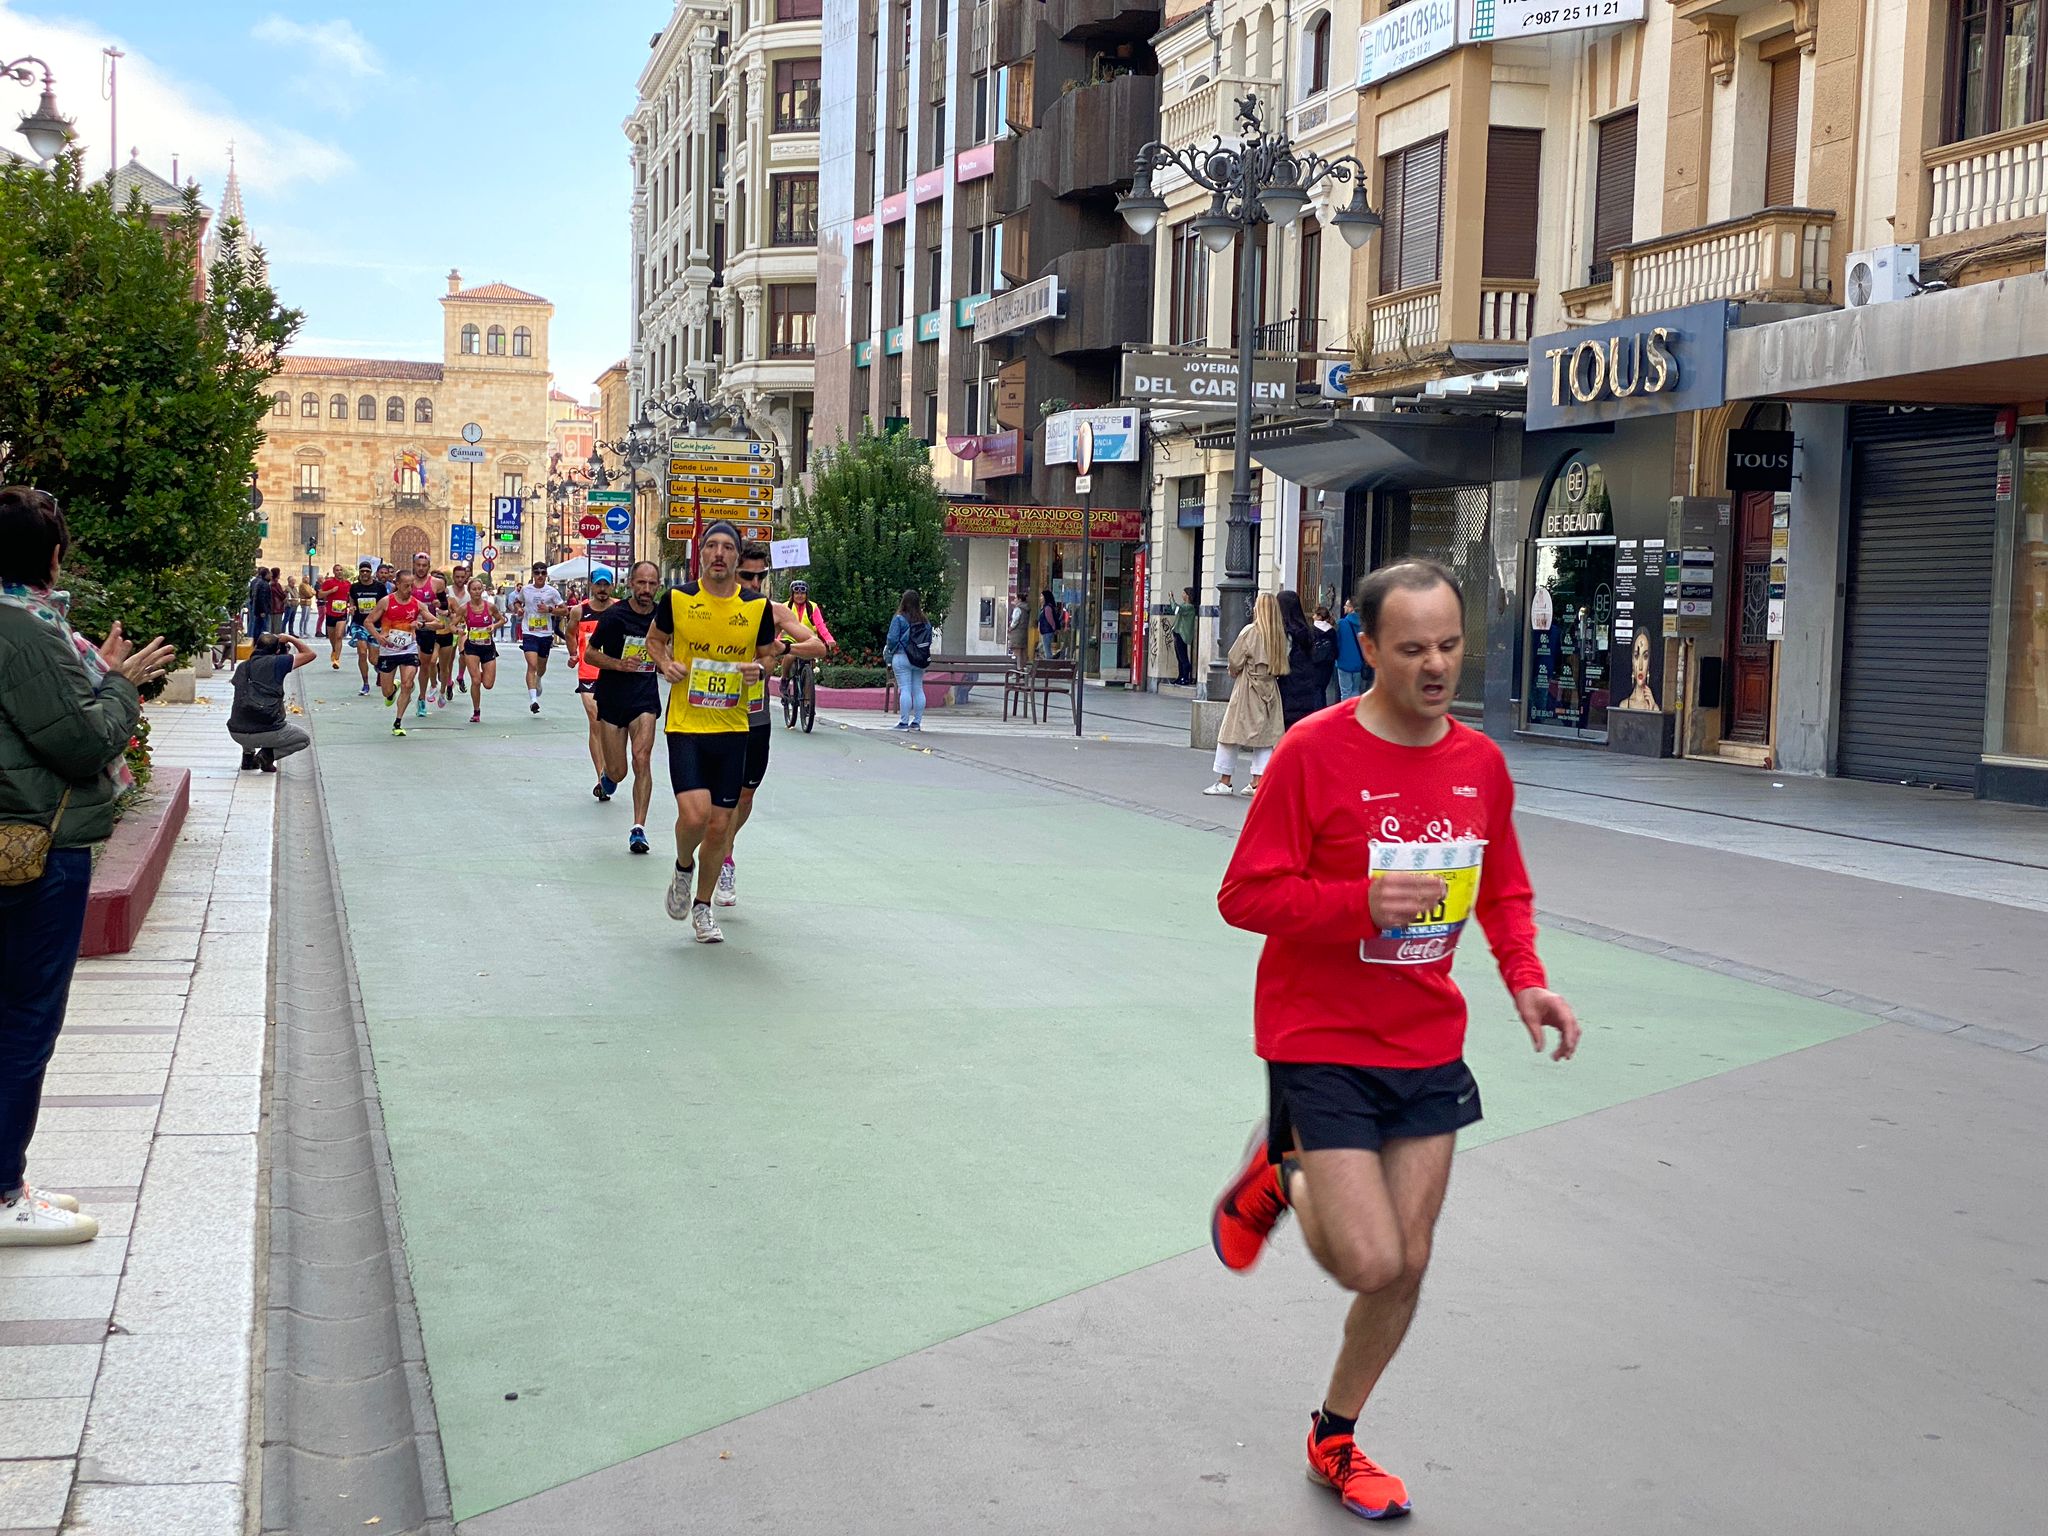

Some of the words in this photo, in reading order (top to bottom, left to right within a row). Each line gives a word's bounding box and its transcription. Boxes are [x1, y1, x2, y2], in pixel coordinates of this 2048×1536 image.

[1535, 10, 1561, 25] 987
[1563, 7, 1580, 21] 25
[1585, 5, 1598, 18] 11
[1604, 2, 1619, 15] 21
[1184, 363, 1239, 375] JOYERIA
[1546, 327, 1679, 407] TOUS
[1135, 376, 1177, 394] DEL
[1190, 379, 1286, 399] CAREN
[751, 444, 759, 454] P
[672, 463, 697, 471] Conde
[700, 464, 718, 472] Luna
[1734, 453, 1789, 468] TOUS
[703, 485, 722, 494] León
[1568, 473, 1582, 491] BE
[498, 498, 512, 520] P
[1179, 496, 1204, 508] ESTRELLA
[709, 507, 739, 516] Antonio
[948, 506, 1010, 518] ROYAL
[1018, 508, 1118, 522] TANDOORI
[581, 523, 601, 531] STOP
[1548, 515, 1561, 533] BE
[1563, 512, 1603, 531] BEAUTY
[1596, 594, 1610, 612] BE
[393, 636, 406, 646] 473
[688, 640, 710, 651] rua
[716, 644, 747, 656] nova
[708, 675, 727, 693] 63
